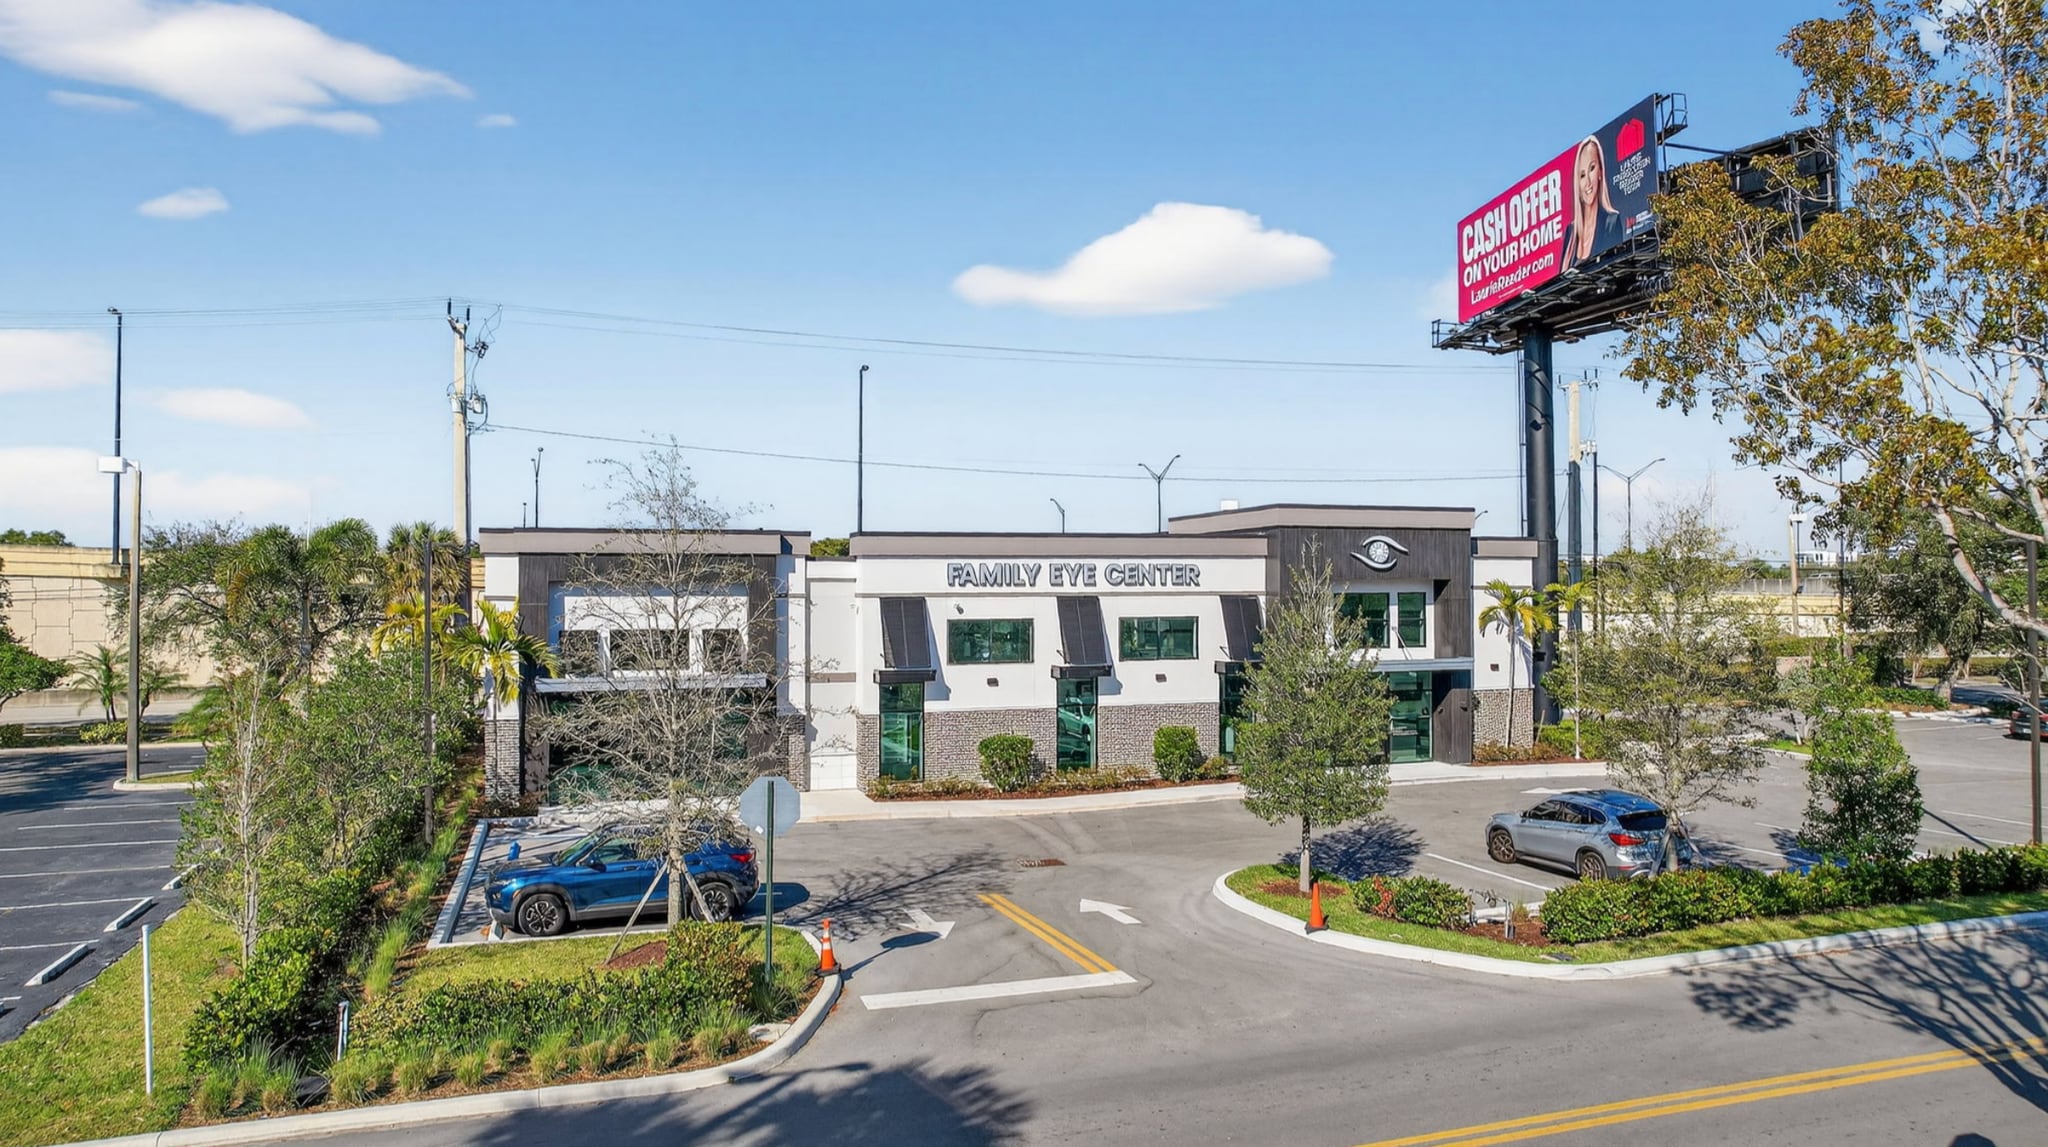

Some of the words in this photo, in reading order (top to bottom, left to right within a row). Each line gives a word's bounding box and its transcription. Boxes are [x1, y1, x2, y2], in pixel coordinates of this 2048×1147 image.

[1463, 203, 1507, 264] CASH
[1509, 169, 1562, 237] OFFER
[1463, 261, 1482, 287] ON
[1483, 241, 1519, 277] YOUR
[1520, 214, 1562, 258] HOME
[947, 562, 1042, 588] FAMILY
[1049, 562, 1098, 588] EYE
[1104, 562, 1202, 588] CENTER
